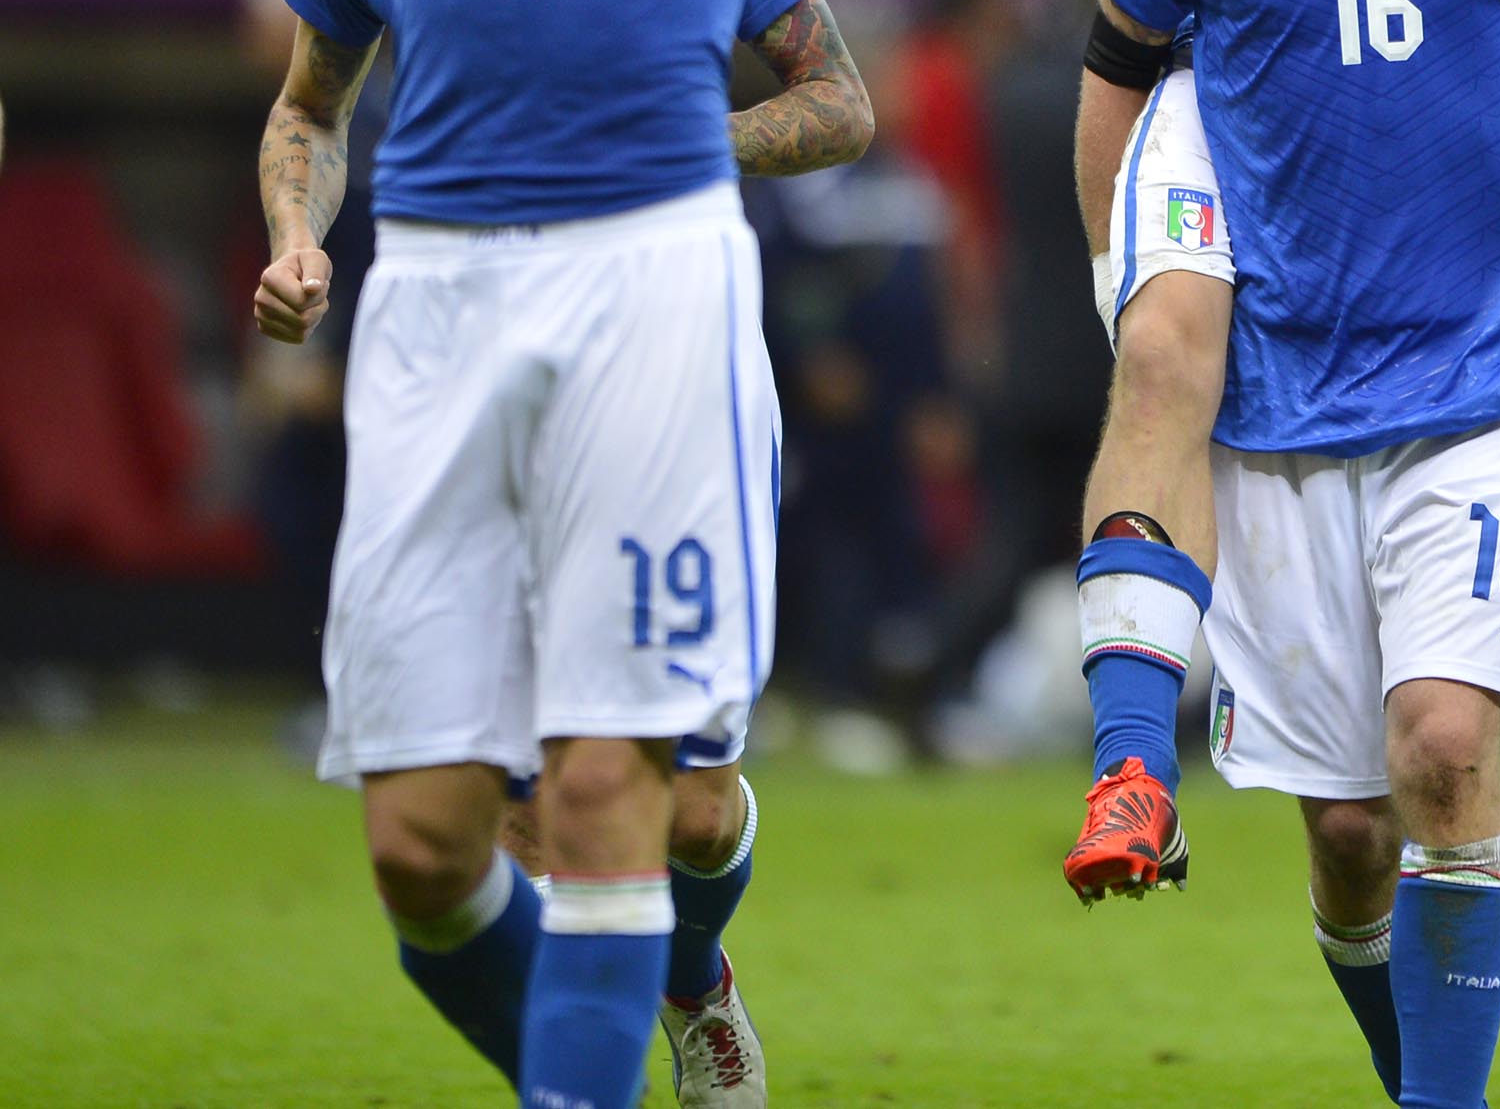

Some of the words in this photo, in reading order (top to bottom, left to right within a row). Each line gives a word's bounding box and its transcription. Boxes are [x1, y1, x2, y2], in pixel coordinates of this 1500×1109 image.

[262, 154, 312, 177] HAPPY
[1173, 191, 1210, 205] ITALIA
[620, 536, 717, 648] 19
[1447, 973, 1500, 989] ITALIA
